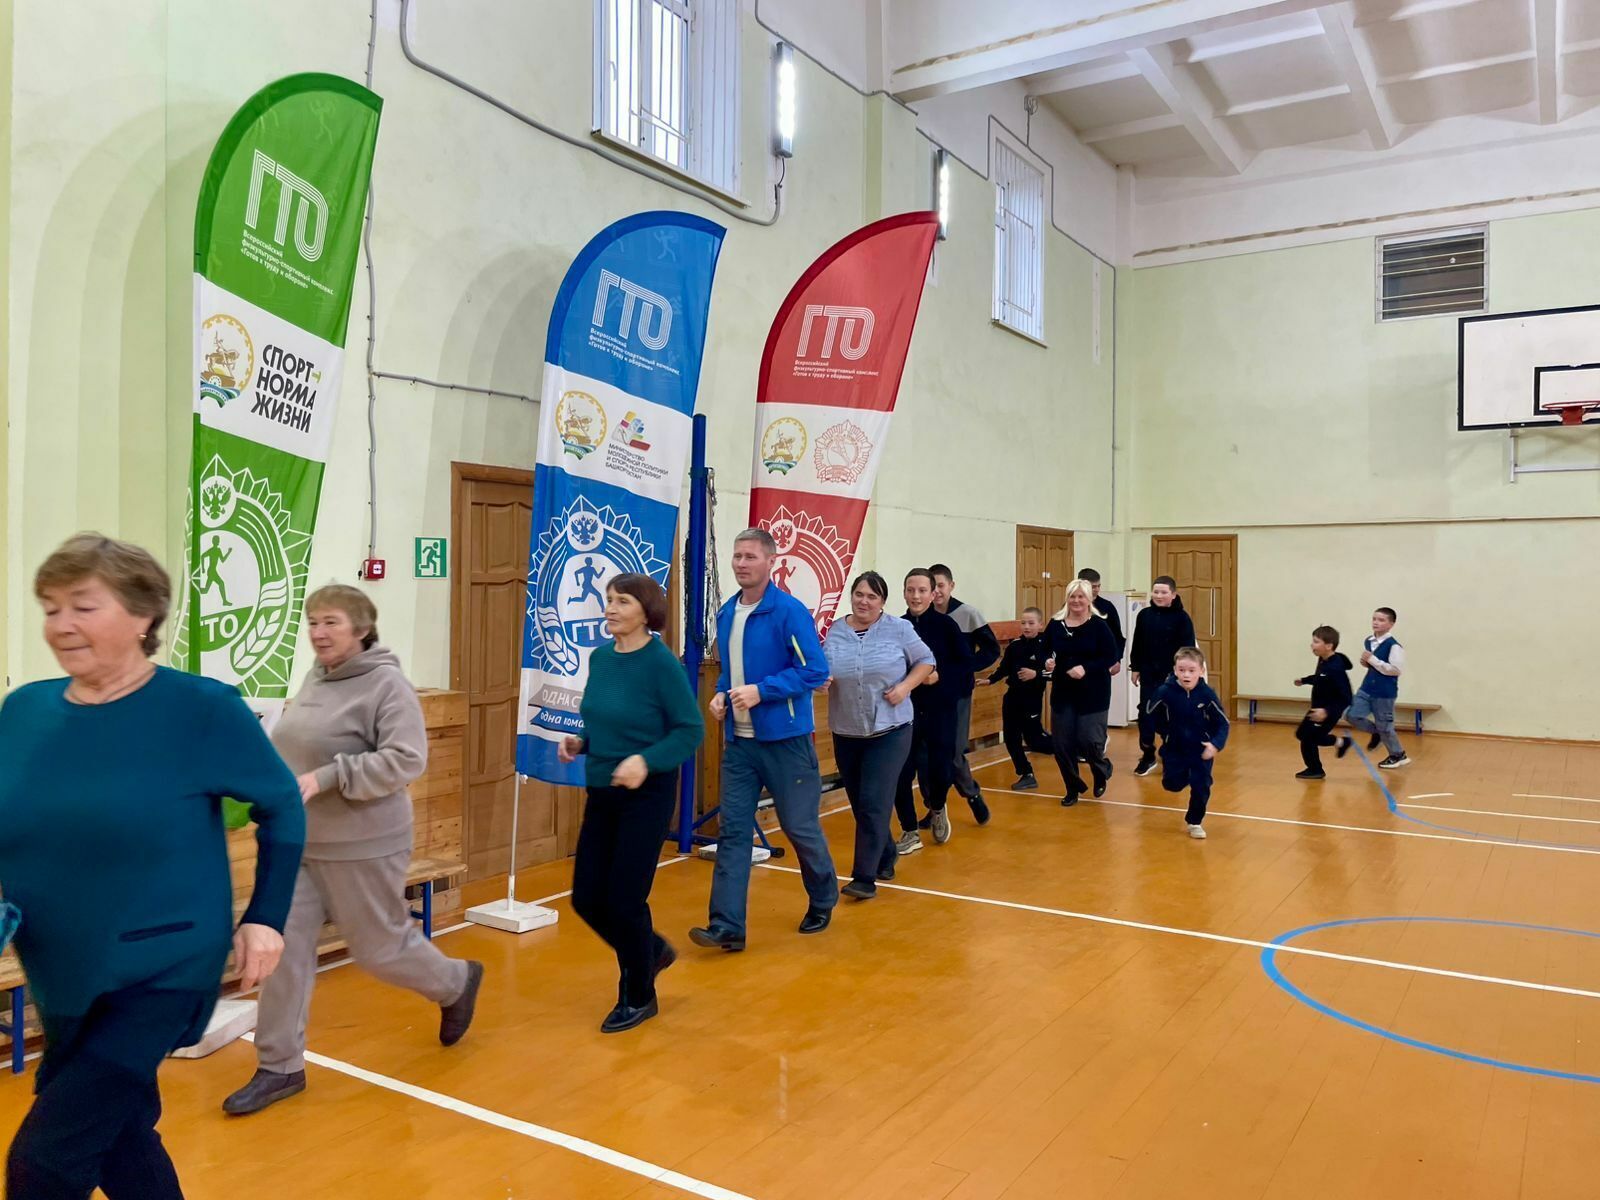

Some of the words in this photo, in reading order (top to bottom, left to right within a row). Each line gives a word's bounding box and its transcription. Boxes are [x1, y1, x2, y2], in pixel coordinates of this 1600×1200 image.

[245, 148, 329, 262] ГТО
[243, 229, 283, 258] Всероссийский
[264, 260, 280, 274] труду
[592, 268, 673, 350] ГТО
[590, 327, 627, 348] Всероссийский
[797, 304, 875, 360] ГТО
[611, 350, 624, 361] труду
[256, 366, 317, 410] НОРМА
[251, 391, 312, 433] ЖИЗНИ
[201, 613, 239, 642] ТО
[542, 689, 570, 706] ОДНА
[540, 710, 562, 724] одна
[563, 716, 584, 728] кома
